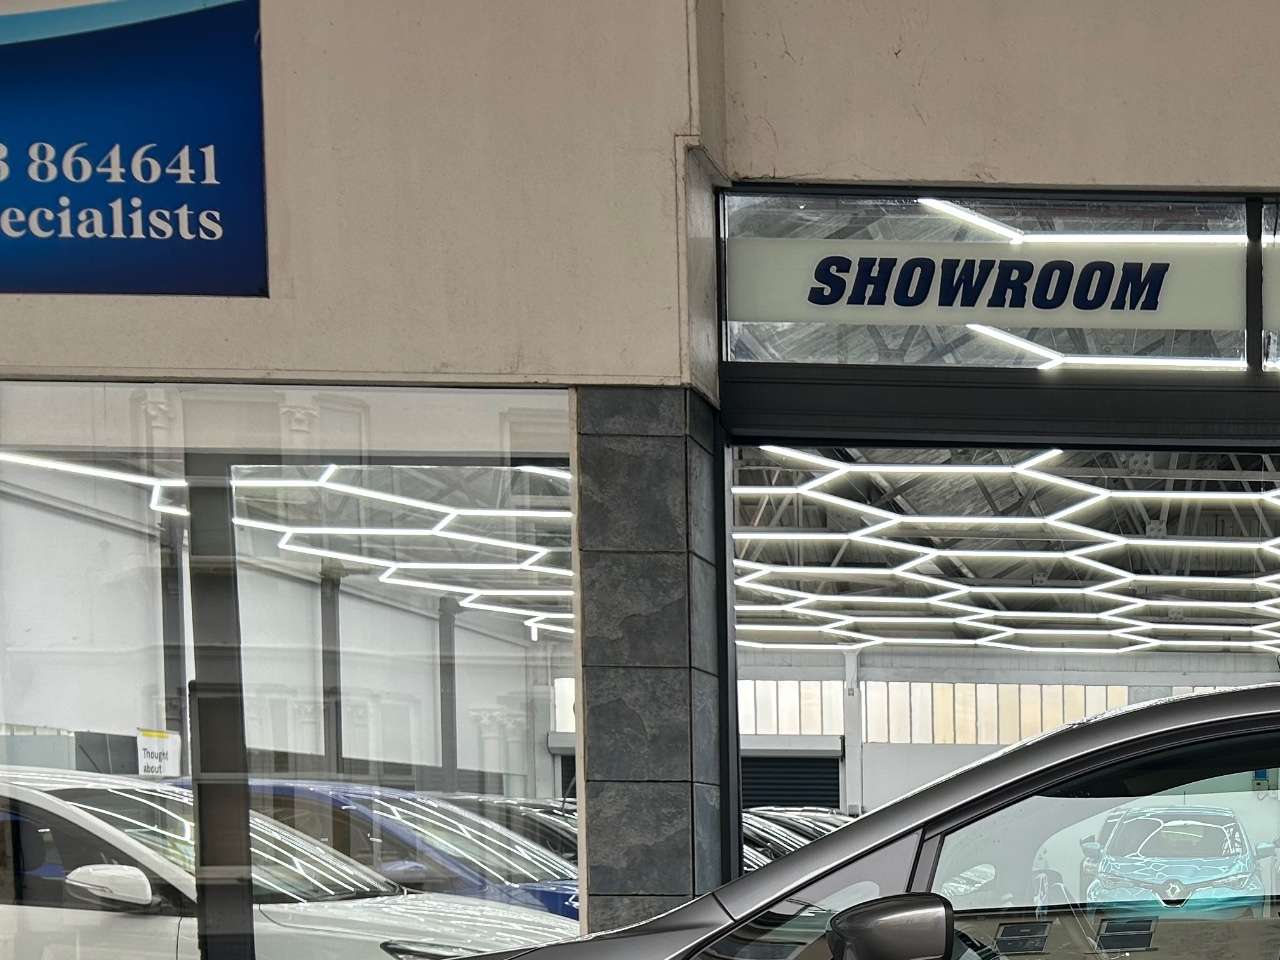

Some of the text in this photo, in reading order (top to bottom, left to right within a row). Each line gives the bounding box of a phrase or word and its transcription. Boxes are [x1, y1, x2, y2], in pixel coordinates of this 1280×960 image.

[27, 142, 221, 185] 864641
[0, 195, 224, 240] ecialists
[807, 255, 1171, 311] SHOWROOM
